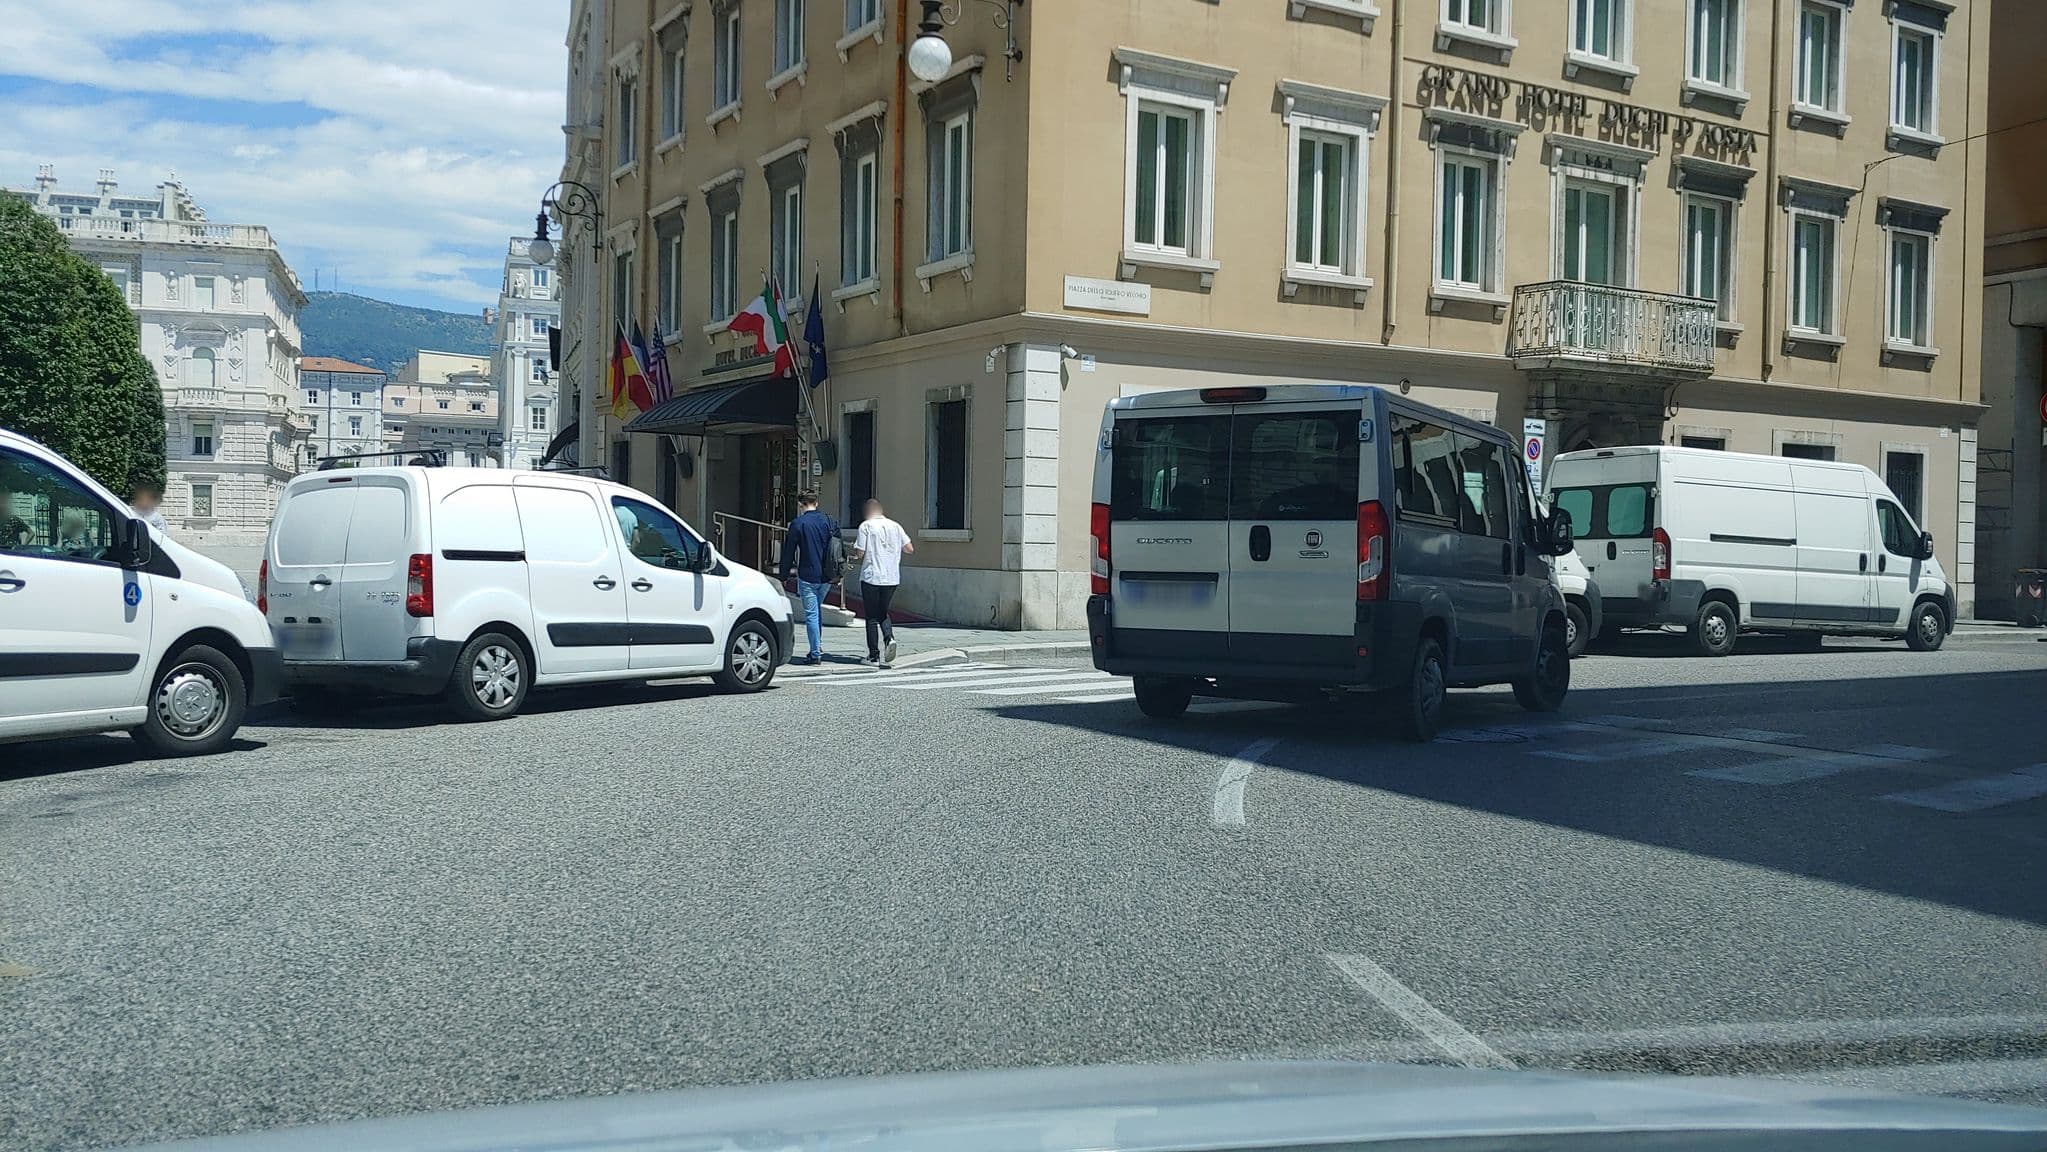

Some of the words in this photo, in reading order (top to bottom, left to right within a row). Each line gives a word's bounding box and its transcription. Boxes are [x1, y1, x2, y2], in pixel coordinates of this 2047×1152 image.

[1422, 64, 1511, 101] GRAND
[1521, 83, 1592, 119] HOTEL
[1604, 100, 1668, 135] DUCHI
[127, 585, 138, 603] 4
